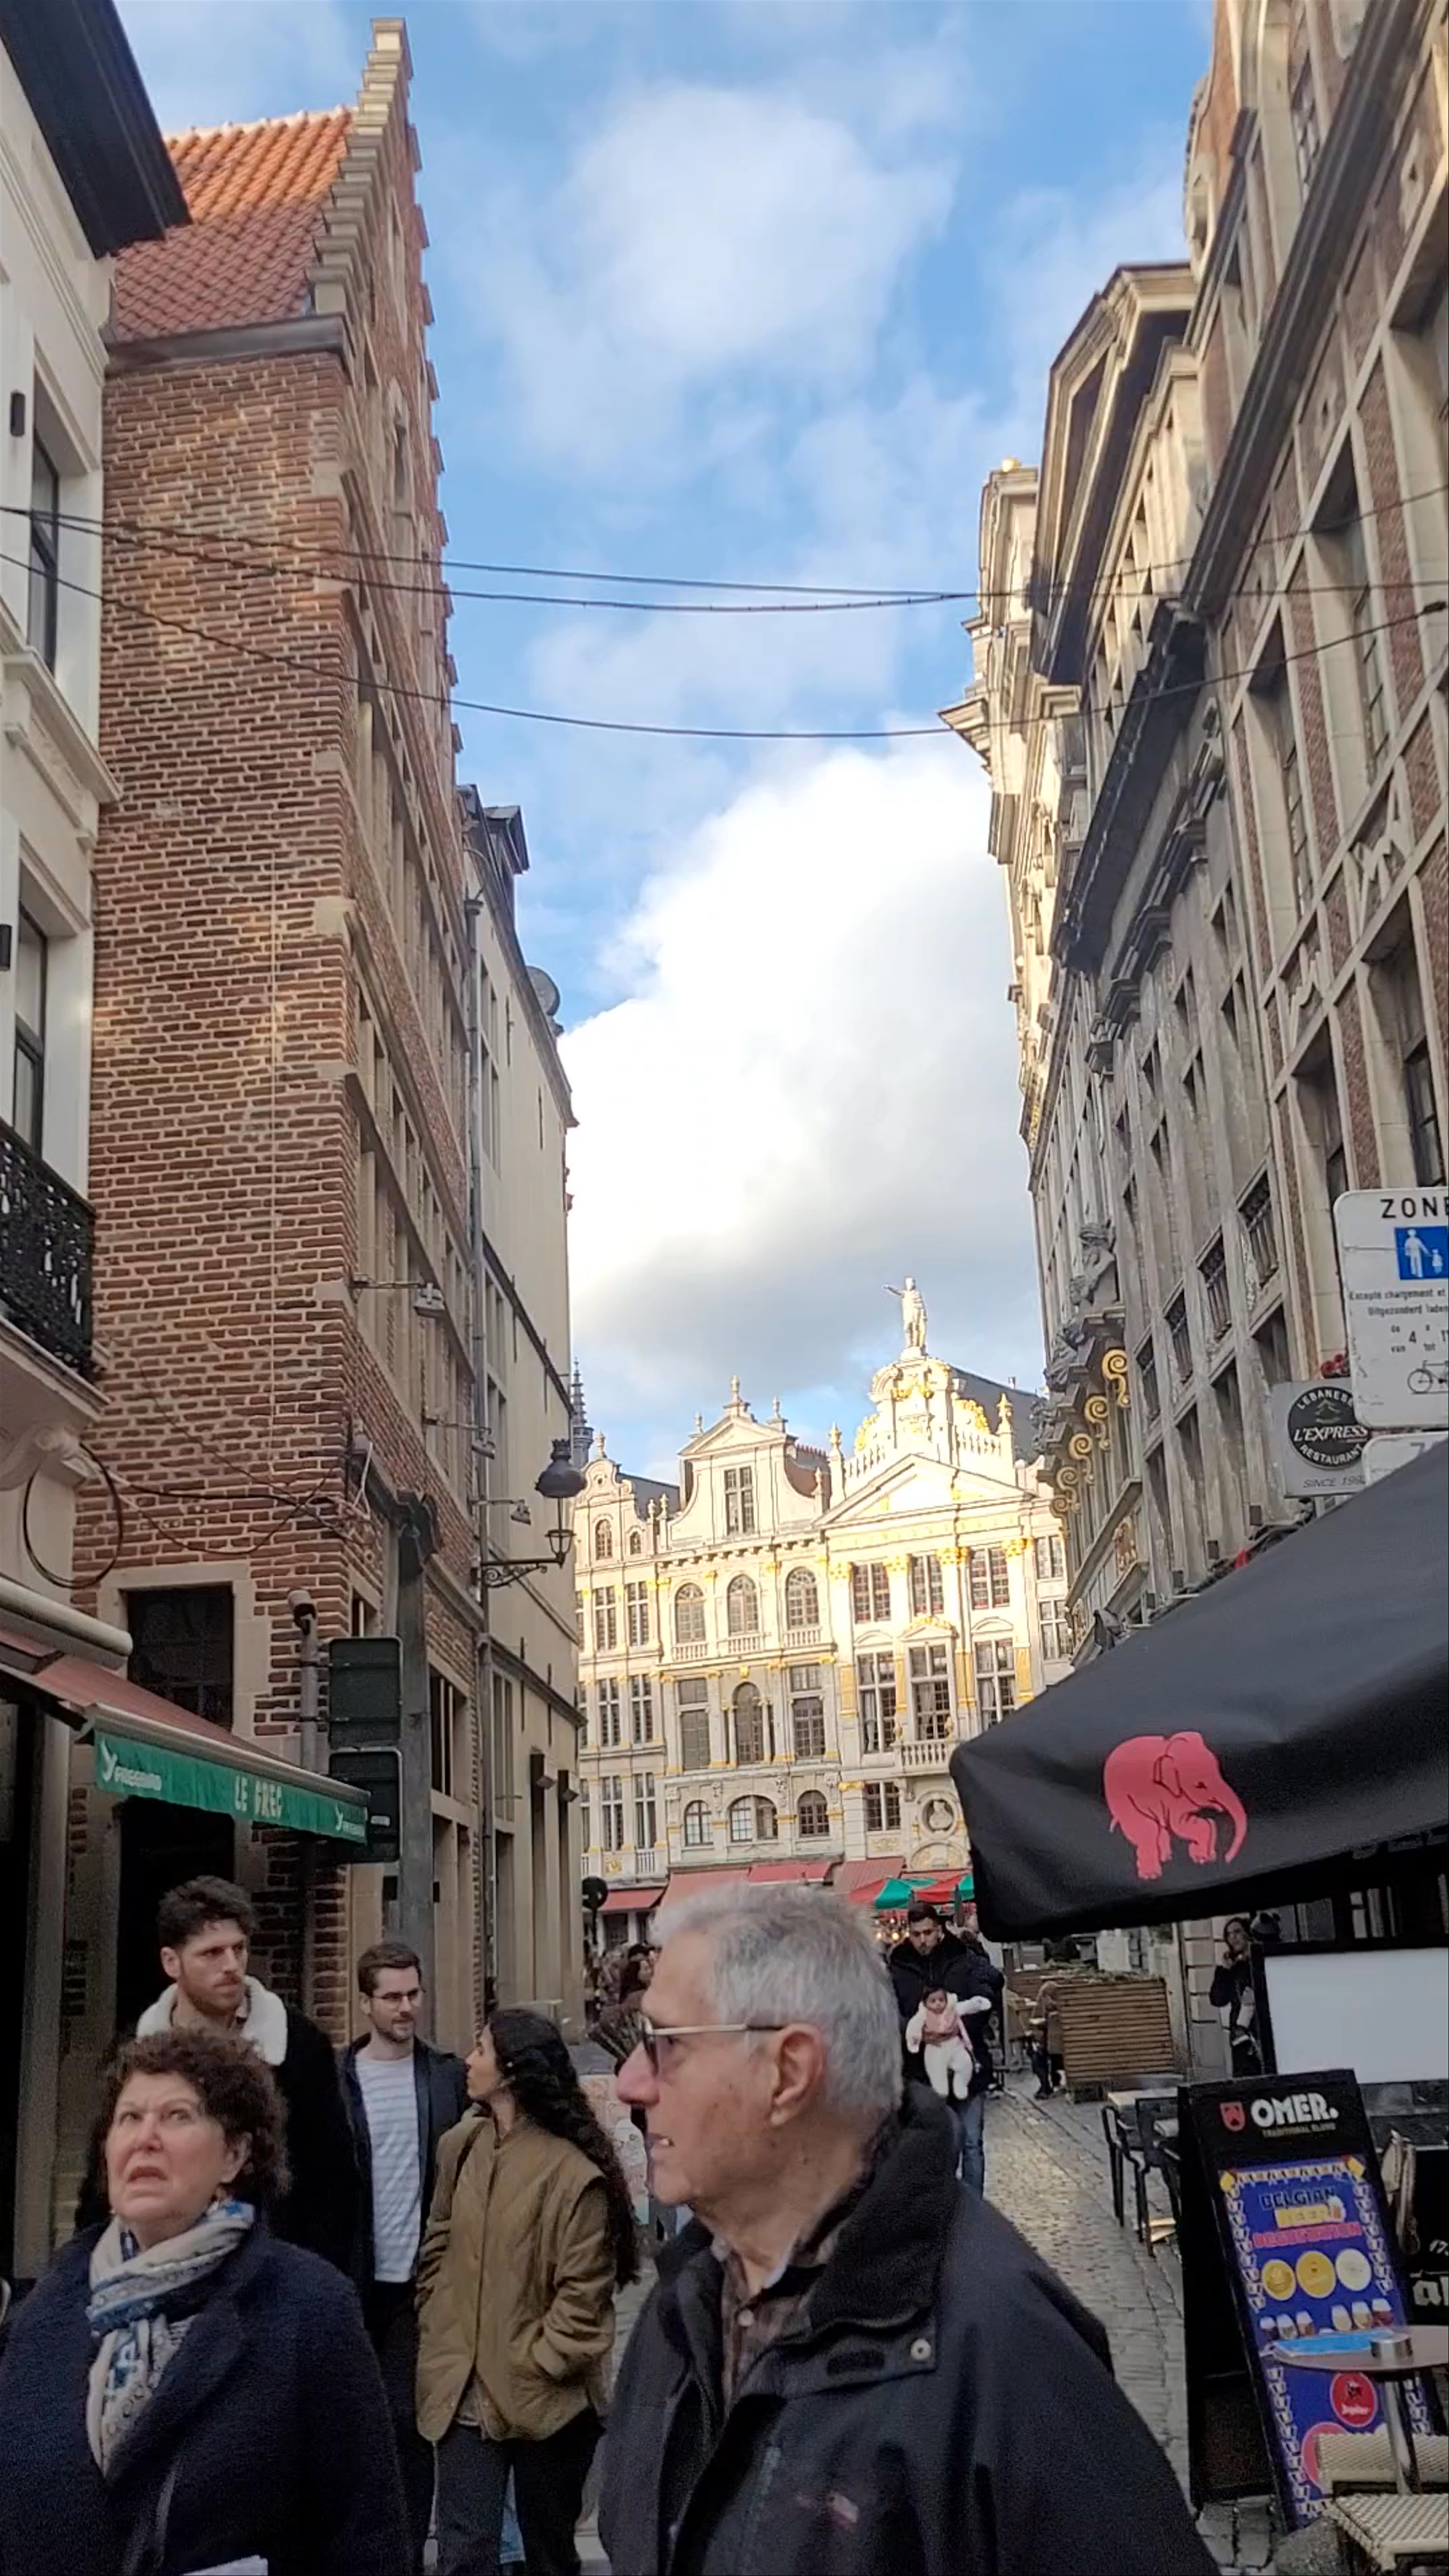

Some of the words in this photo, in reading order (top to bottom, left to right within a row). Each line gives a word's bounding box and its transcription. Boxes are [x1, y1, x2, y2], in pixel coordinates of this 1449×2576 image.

[1384, 1289, 1434, 1300] chargement
[1438, 1289, 1446, 1297] et
[1368, 1304, 1422, 1317] Uitgezonderd
[1409, 1330, 1417, 1343] 4
[1294, 1425, 1369, 1442] L'EXPRESS
[1300, 1443, 1363, 1465] RESTAURANT
[1303, 1478, 1337, 1488] SINCE
[1259, 2188, 1336, 2210] BELGIAN
